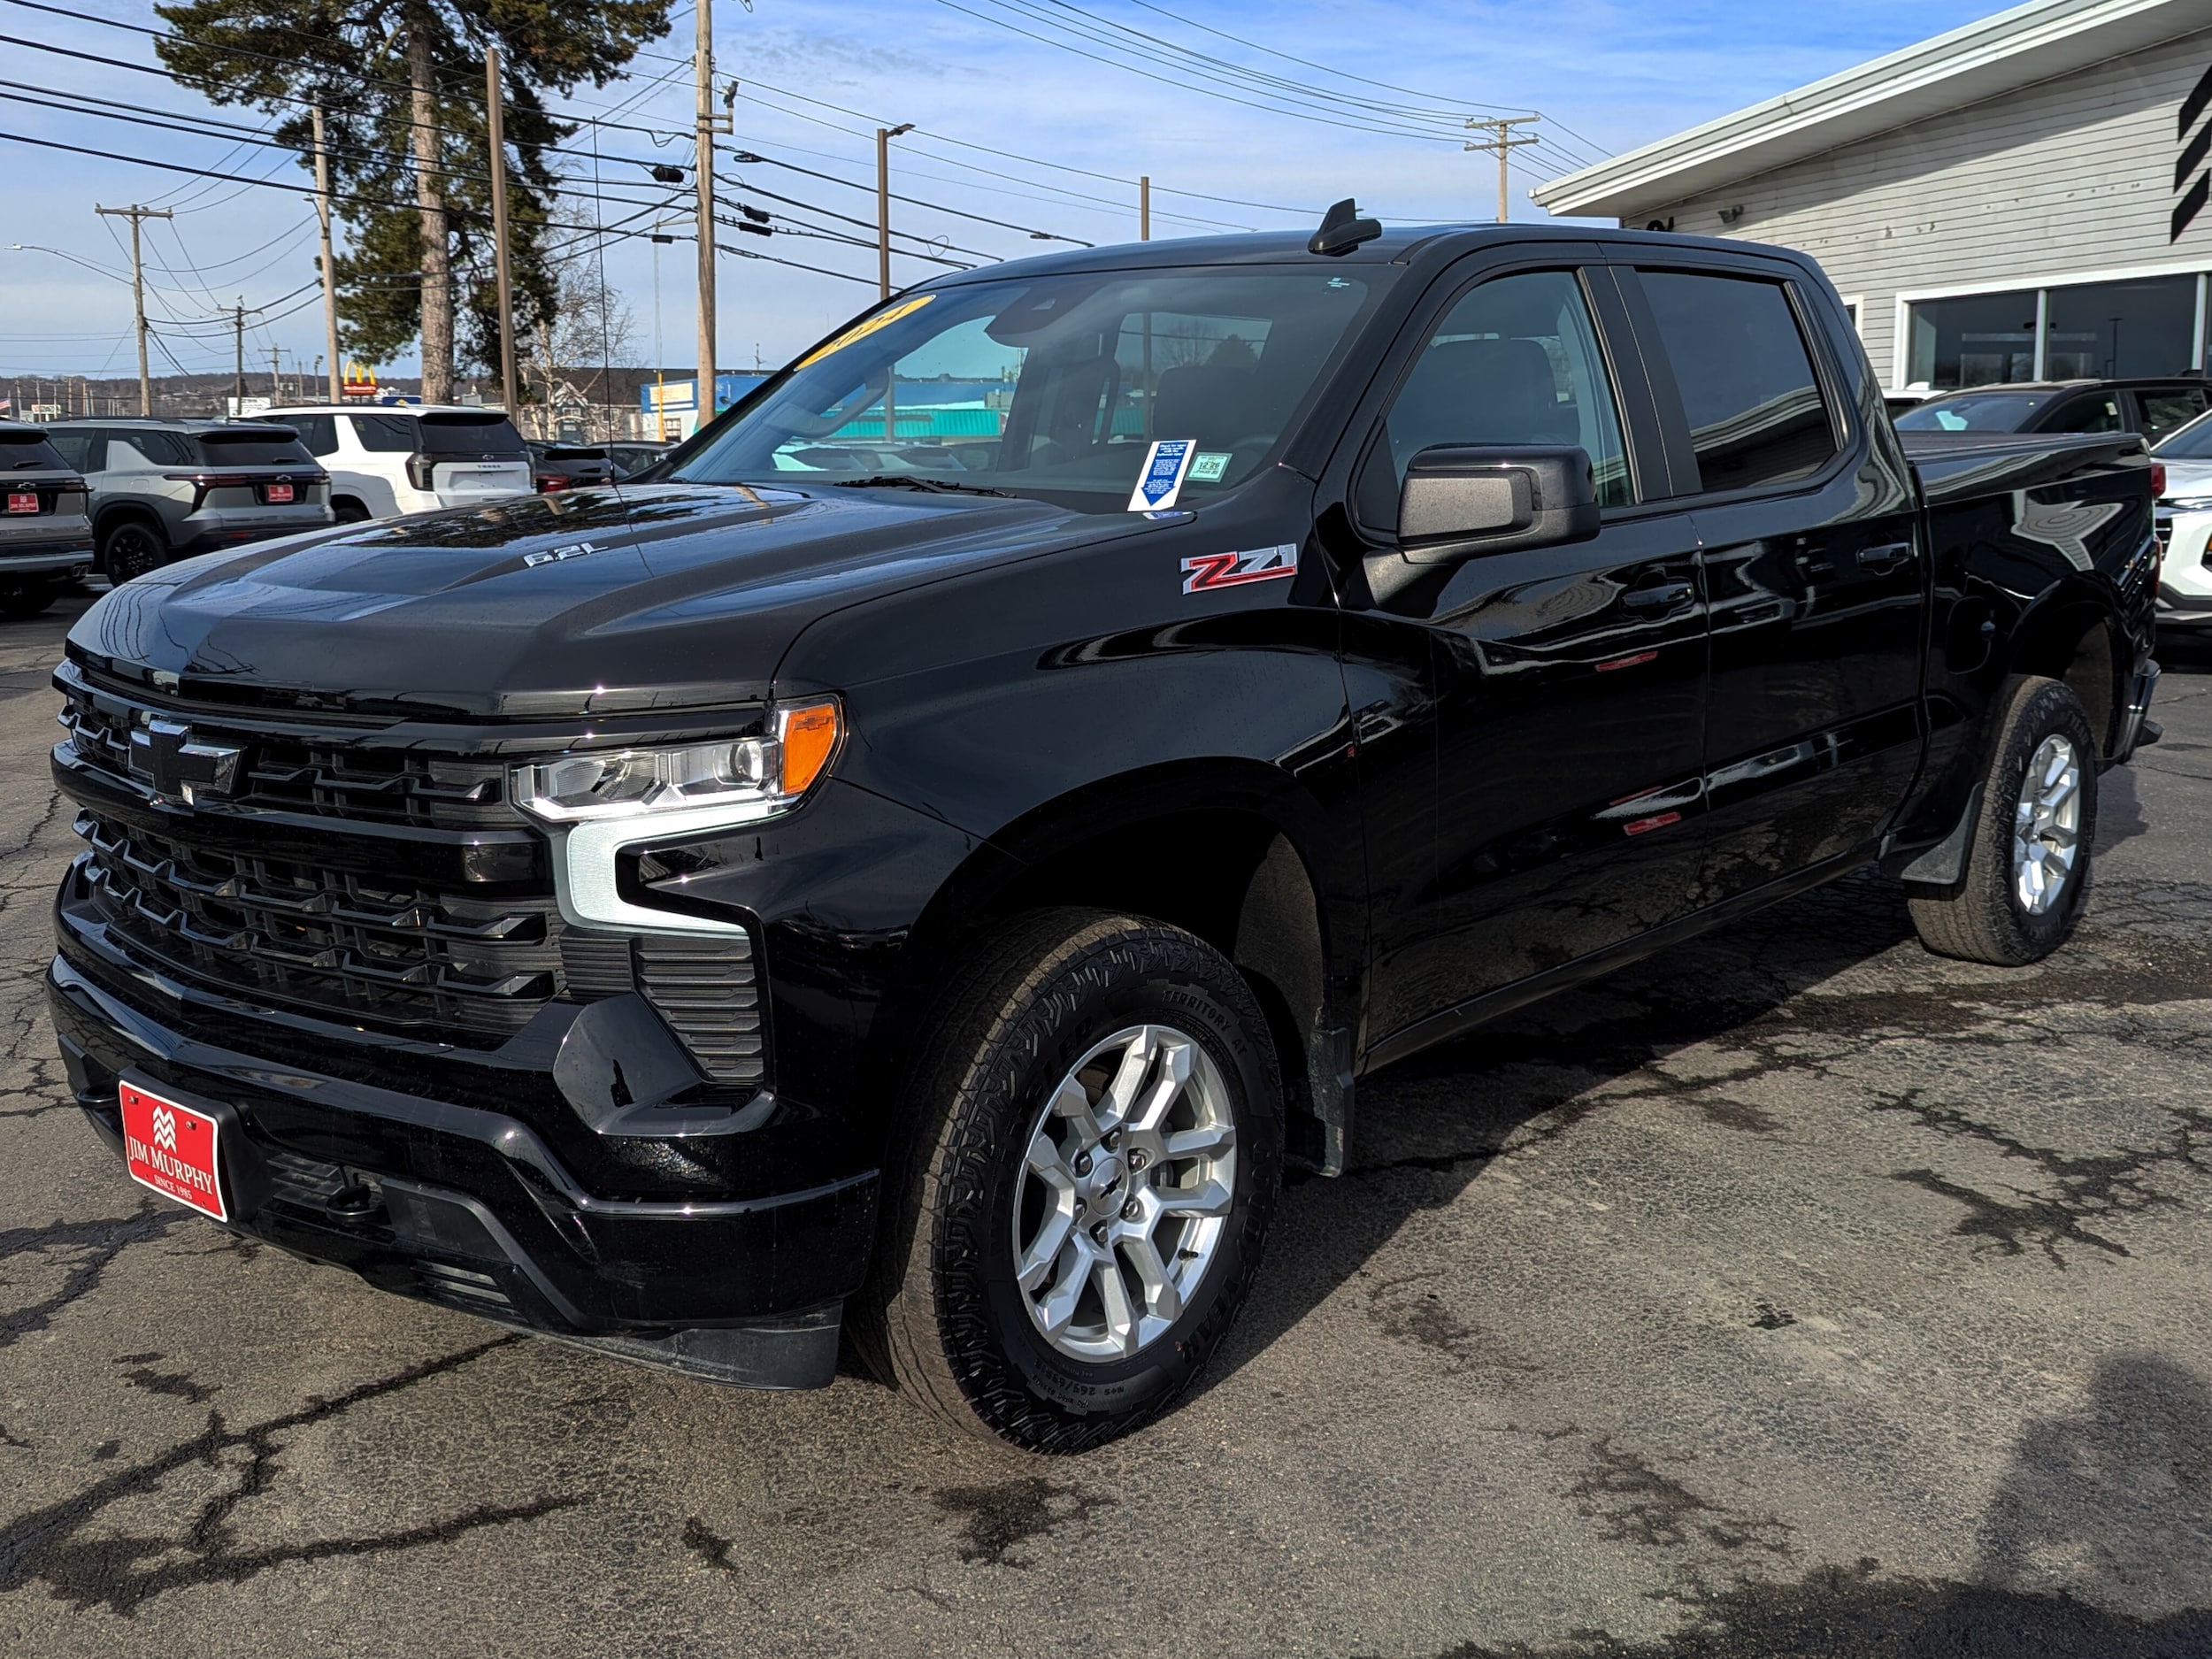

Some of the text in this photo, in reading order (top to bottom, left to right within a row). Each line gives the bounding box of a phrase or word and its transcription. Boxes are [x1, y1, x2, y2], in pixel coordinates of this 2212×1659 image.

[1180, 542, 1298, 595] Z71
[1162, 989, 1233, 1033] TERRITORY
[1232, 1037, 1249, 1056] AT
[128, 1136, 213, 1195] JIM MURPHY
[153, 1174, 175, 1194] SINCE
